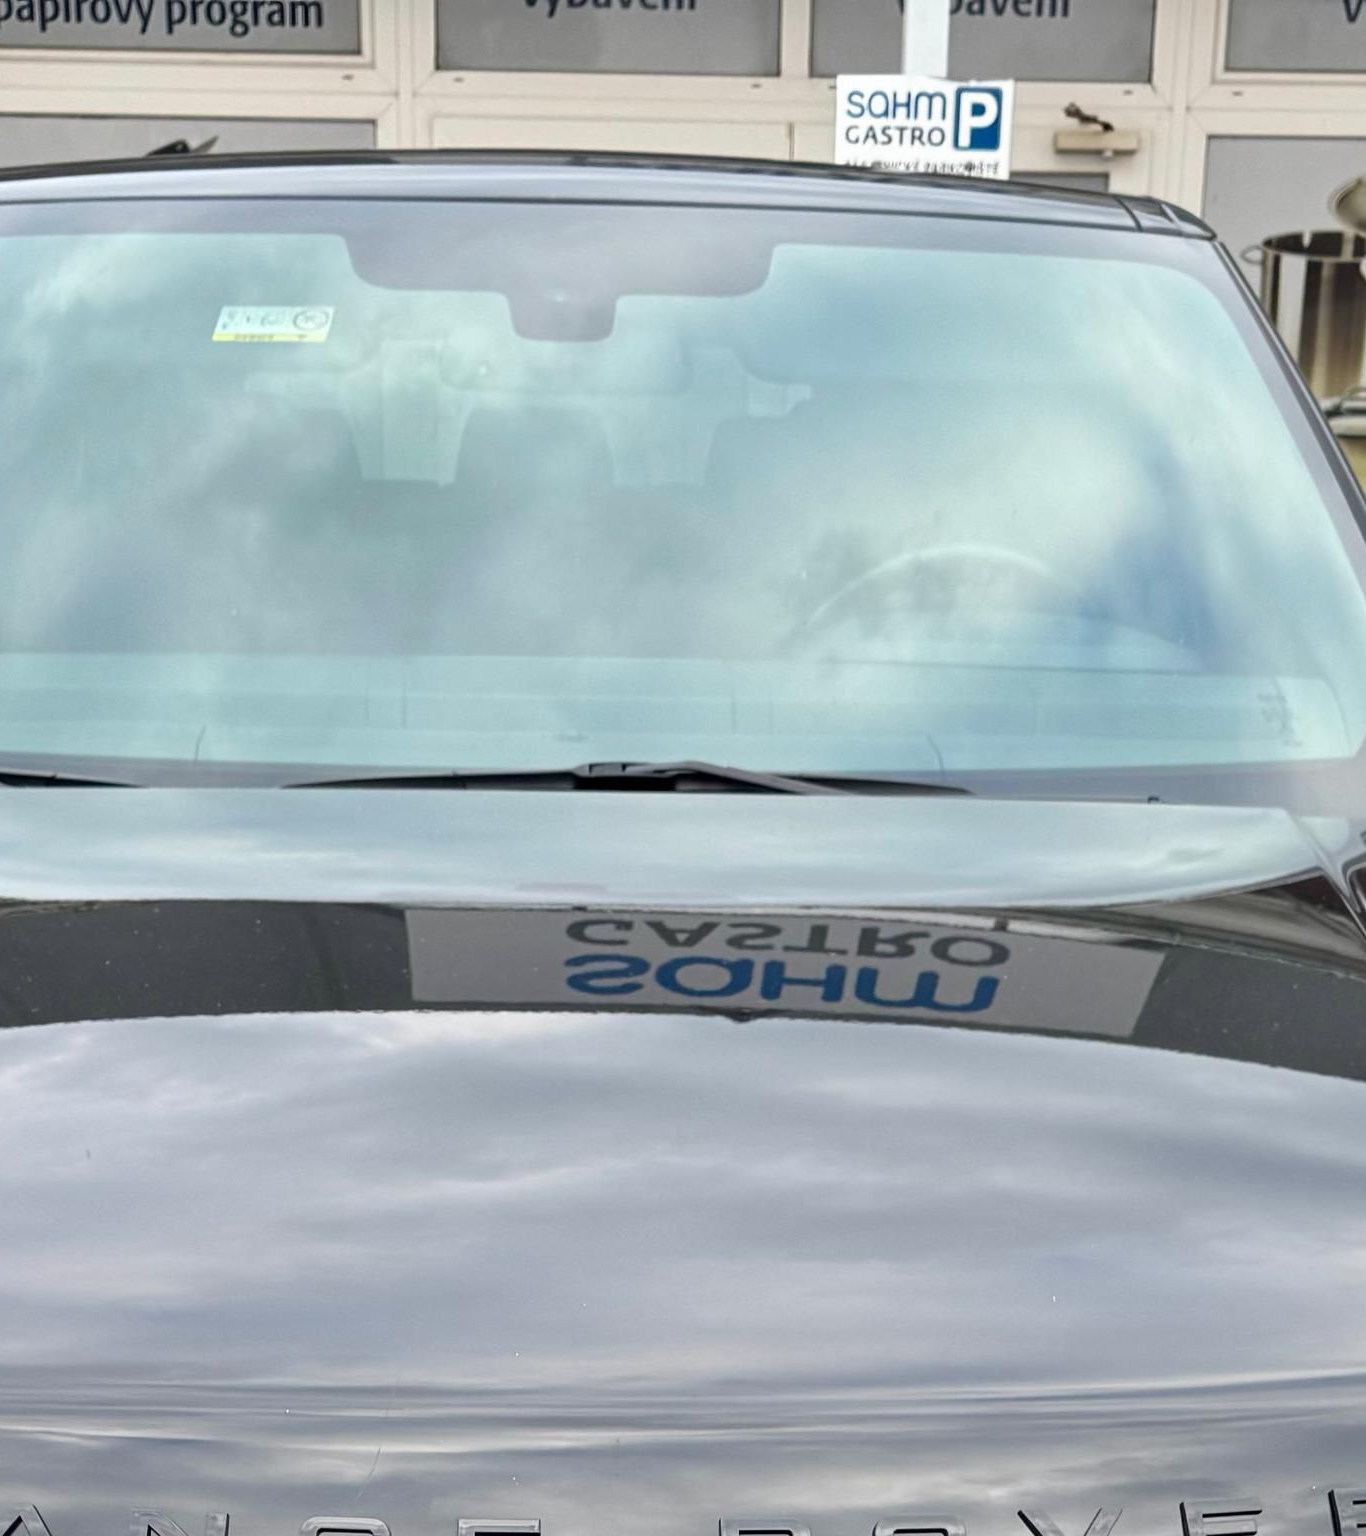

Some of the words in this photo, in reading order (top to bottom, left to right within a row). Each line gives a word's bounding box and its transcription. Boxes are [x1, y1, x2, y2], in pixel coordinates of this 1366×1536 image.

[164, 0, 323, 36] program
[845, 125, 946, 147] GASTRO
[958, 91, 998, 148] P
